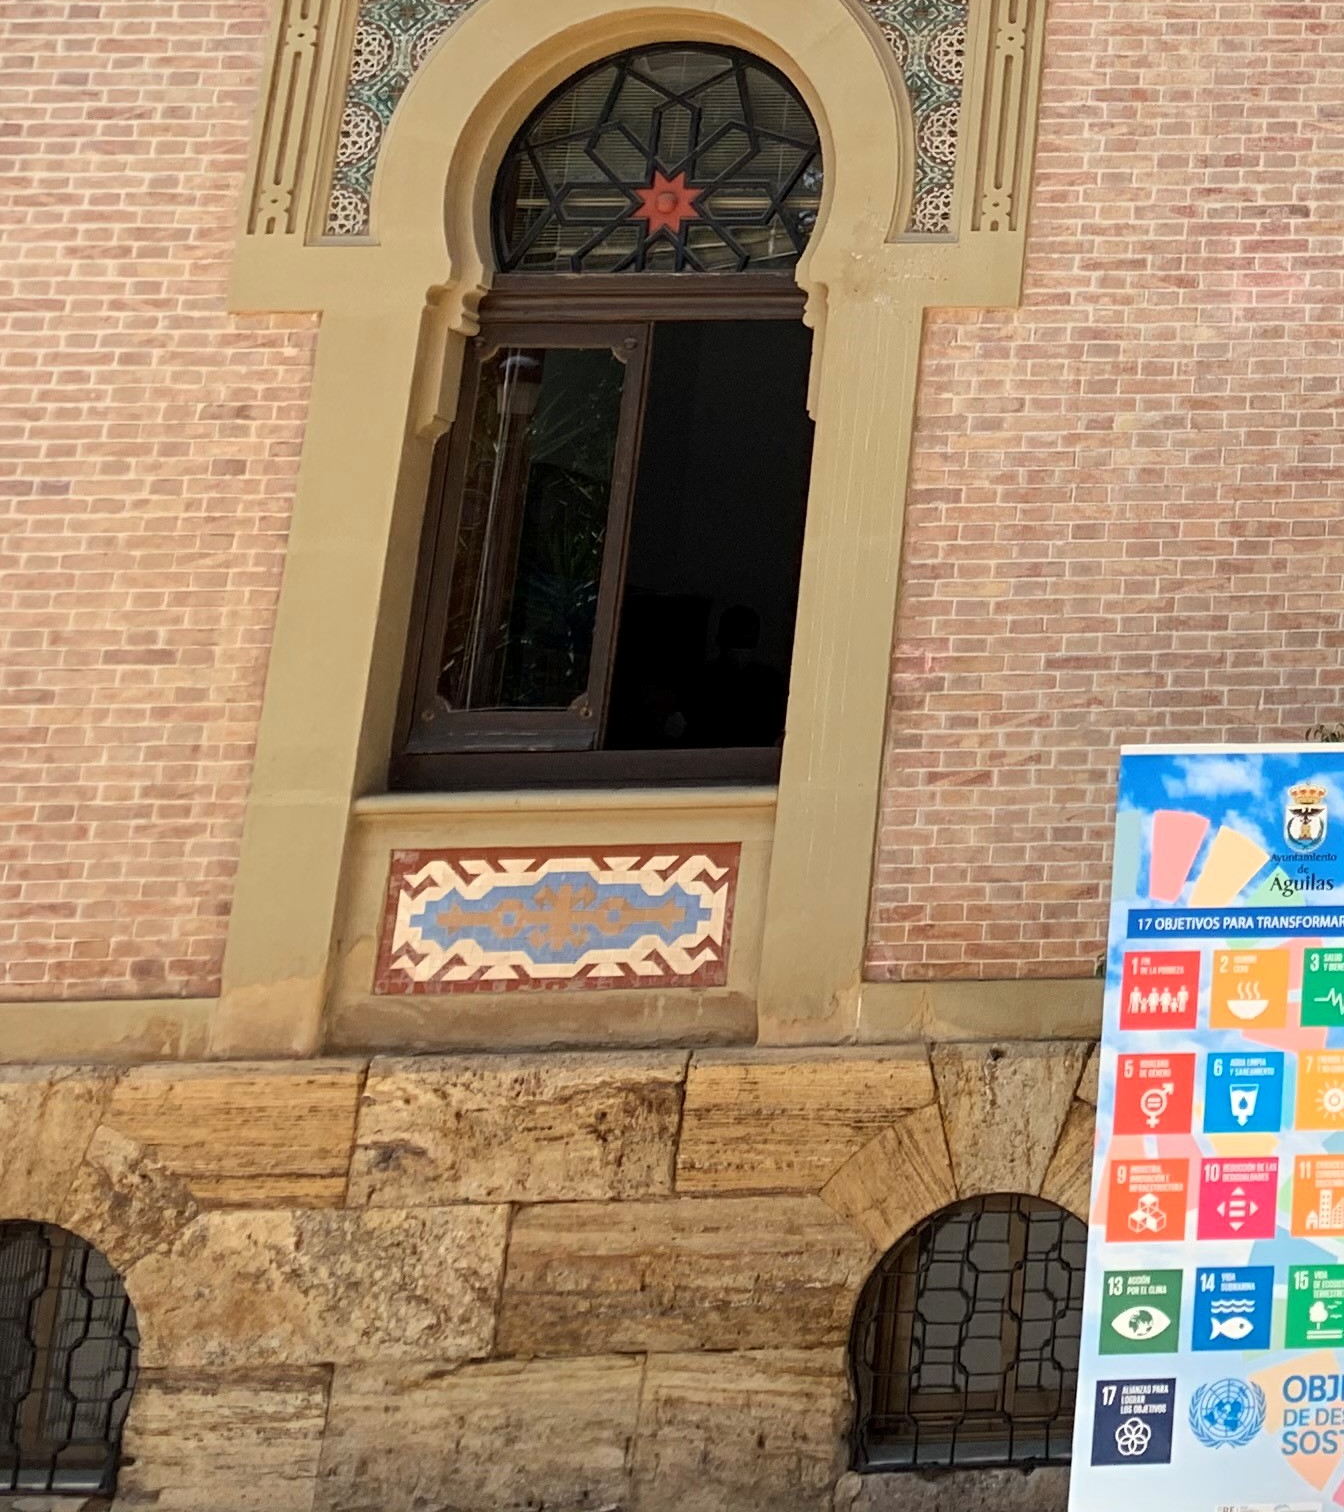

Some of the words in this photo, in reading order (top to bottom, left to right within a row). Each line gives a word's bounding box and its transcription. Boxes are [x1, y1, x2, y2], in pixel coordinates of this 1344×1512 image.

[1270, 852, 1338, 864] Ayuntamiento
[1297, 865, 1310, 874] de
[1269, 872, 1334, 897] Águilas
[1137, 917, 1151, 930] 17
[1154, 916, 1220, 930] OBJETIVOS
[1223, 916, 1254, 929] PARA
[1131, 957, 1139, 975] 1
[1219, 955, 1229, 974] 2
[1309, 953, 1320, 972] 3
[1124, 1059, 1134, 1078] 5
[1213, 1058, 1223, 1077] 6
[1117, 1165, 1127, 1184] 9
[1203, 1163, 1221, 1183] 10
[1299, 1161, 1312, 1179] 11
[1107, 1276, 1124, 1295] 13
[1200, 1273, 1216, 1292] 14
[1294, 1270, 1309, 1290] 15
[1102, 1385, 1117, 1406] 17
[1283, 1408, 1311, 1427] DE
